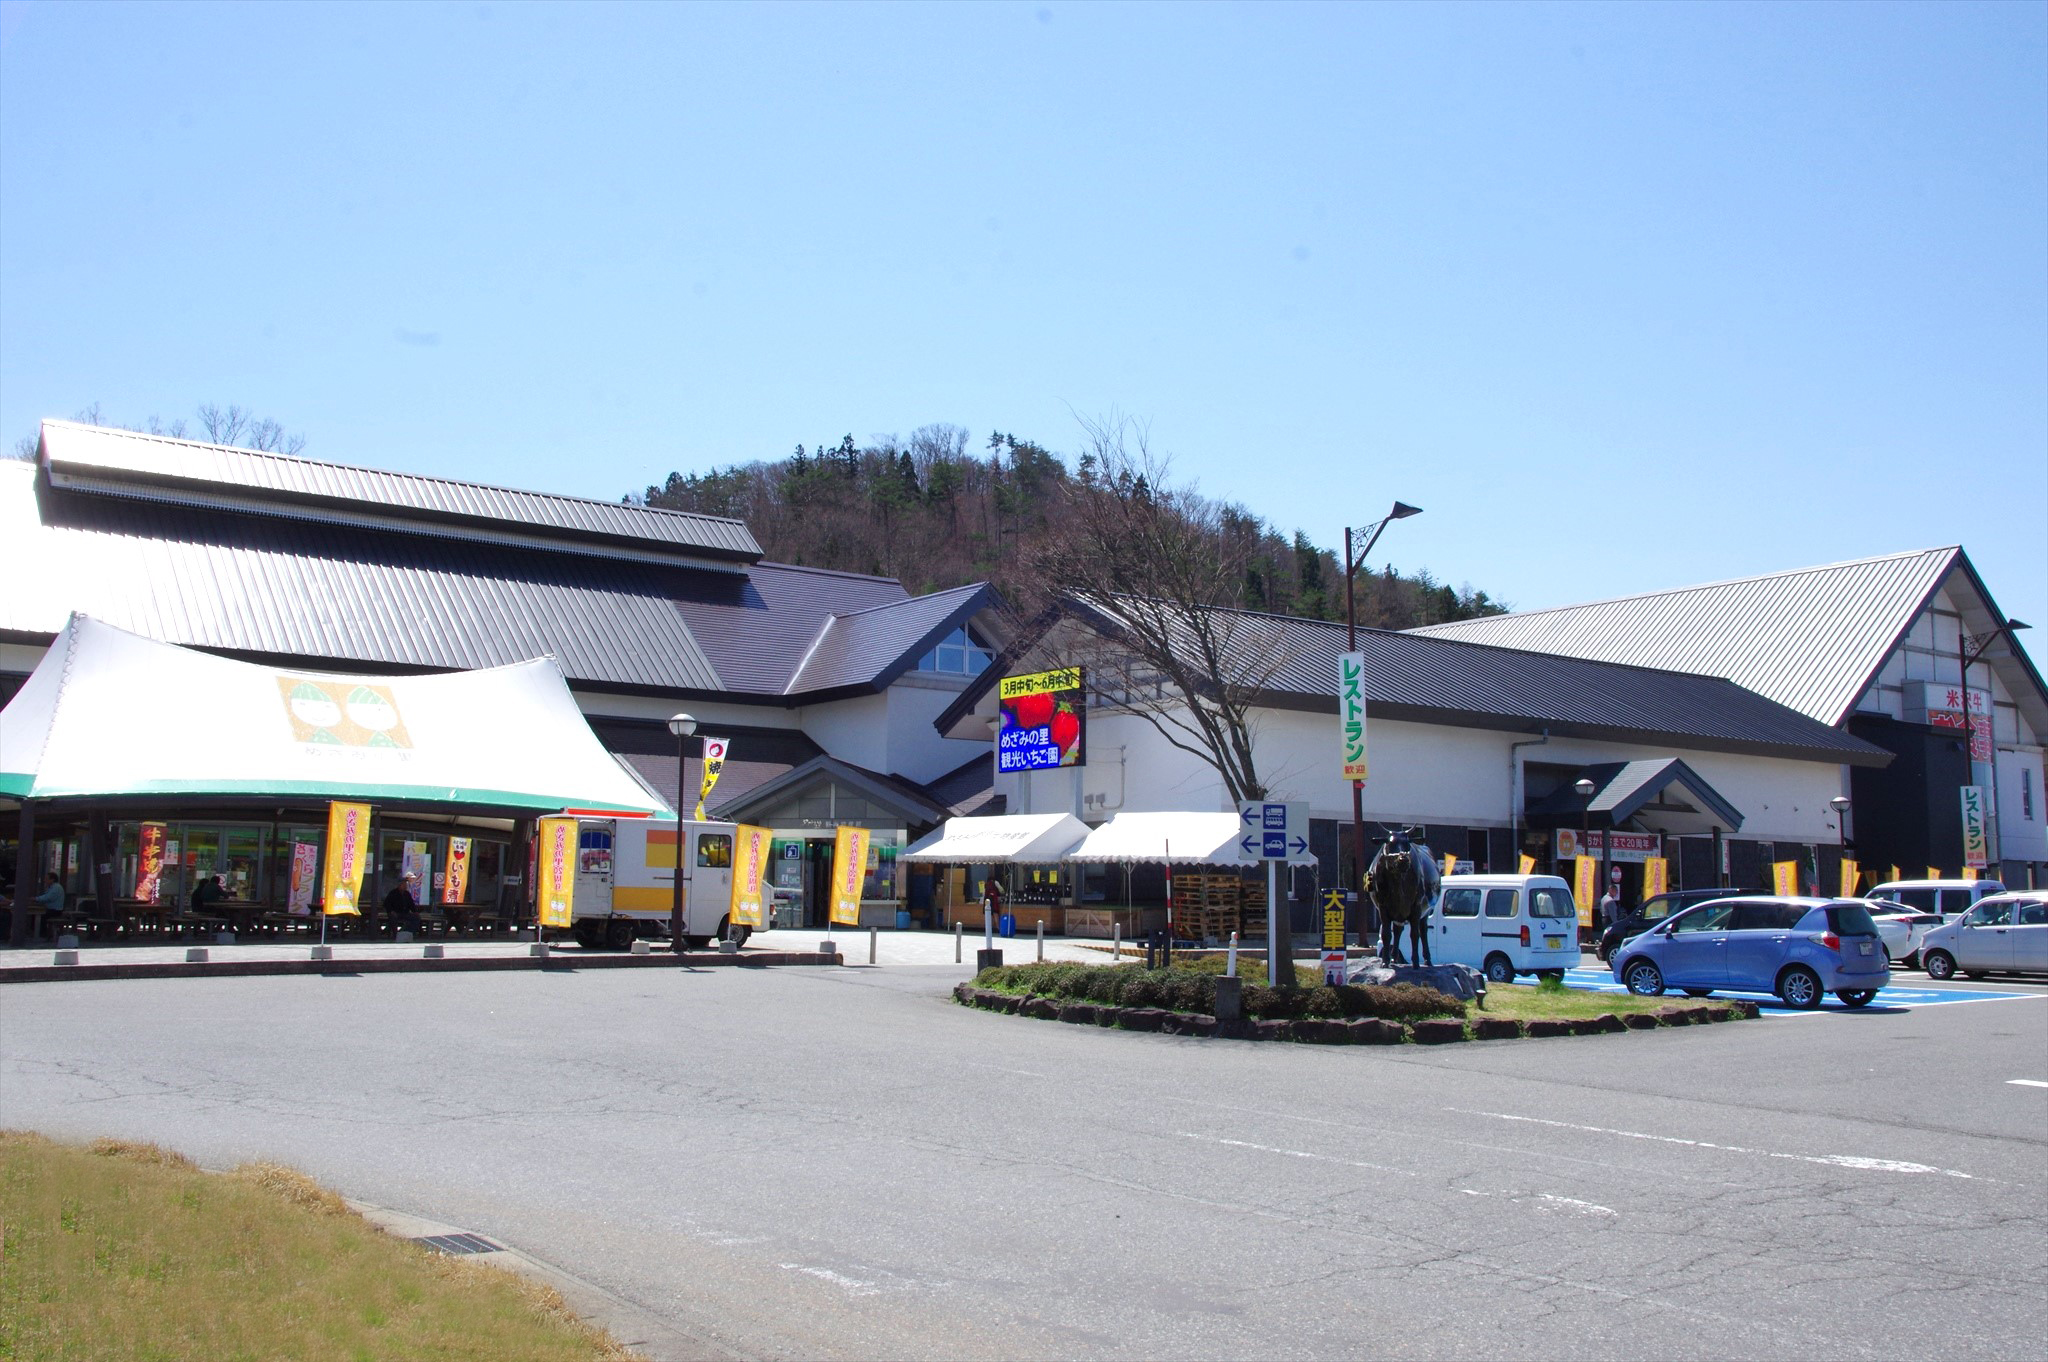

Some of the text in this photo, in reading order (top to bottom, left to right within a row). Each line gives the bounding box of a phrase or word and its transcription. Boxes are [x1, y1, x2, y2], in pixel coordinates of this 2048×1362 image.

[1343, 658, 1364, 763] レストラン
[1000, 727, 1049, 748] めざみの里
[1000, 746, 1059, 769] 観光いちご園
[1344, 764, 1366, 775] 歓迎
[1965, 787, 1982, 851] レストラン
[1587, 837, 1650, 849] おかまで20周年
[1967, 851, 1984, 860] 歓迎
[447, 861, 464, 903] いも煮
[1323, 889, 1345, 950] 大型車
